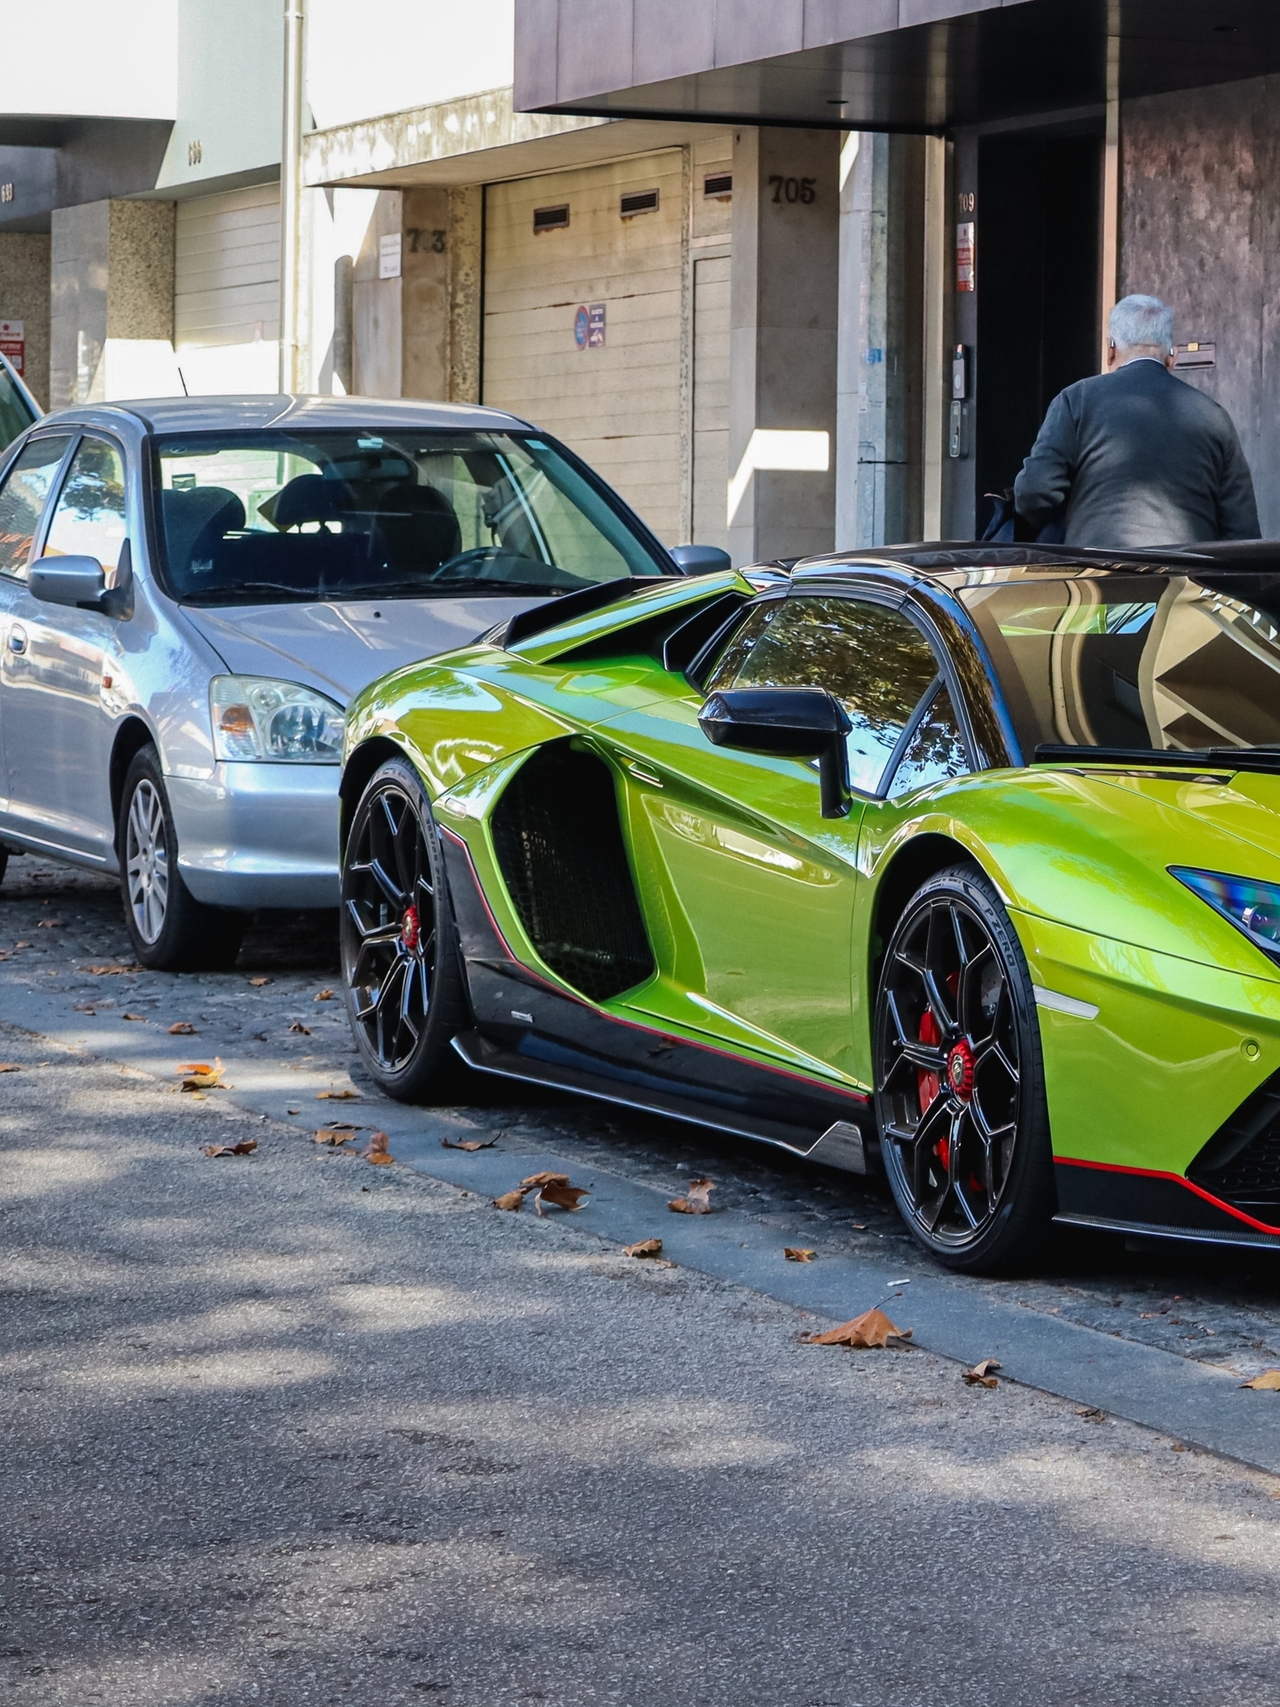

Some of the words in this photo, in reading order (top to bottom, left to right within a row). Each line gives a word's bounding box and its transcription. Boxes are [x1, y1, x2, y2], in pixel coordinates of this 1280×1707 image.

[768, 175, 817, 205] 705
[959, 193, 975, 213] 709
[406, 228, 447, 255] 703
[984, 908, 994, 917] P
[991, 920, 1016, 967] ZERO
